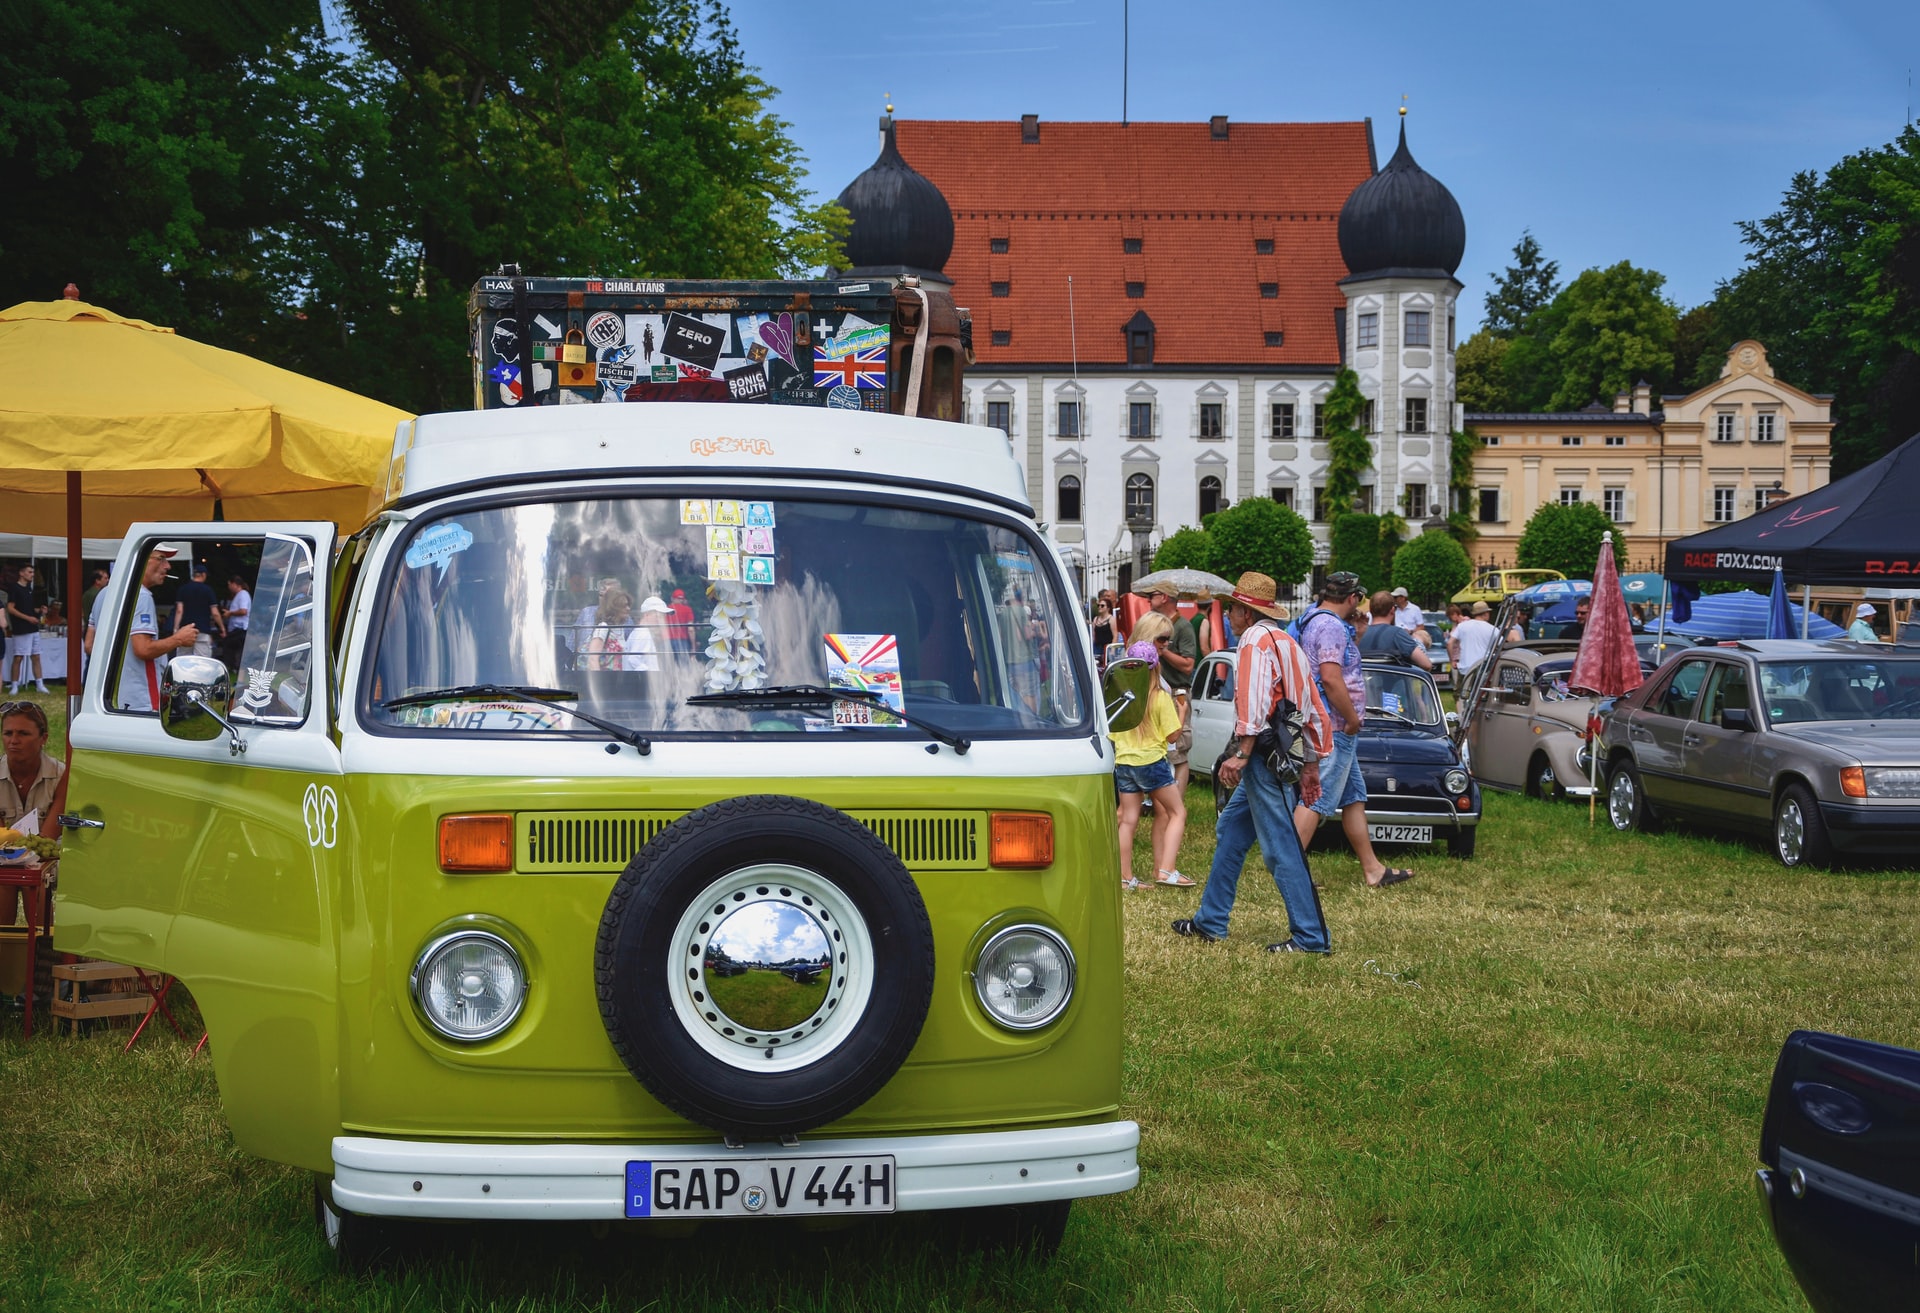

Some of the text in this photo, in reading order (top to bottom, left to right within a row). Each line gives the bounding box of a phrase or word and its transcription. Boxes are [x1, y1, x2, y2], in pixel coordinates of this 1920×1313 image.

[485, 280, 534, 291] HAWII
[586, 281, 665, 293] THE CHARLATANS
[677, 326, 713, 346] ZERO
[825, 330, 890, 360] IBIZA
[600, 367, 633, 377] FISCHER
[729, 372, 764, 390] SONIC
[731, 382, 767, 399] YOUTH
[1684, 553, 1782, 570] RACEFOXX.COM
[836, 713, 868, 723] 2018
[654, 1168, 740, 1210] GAP
[633, 1195, 643, 1207] D
